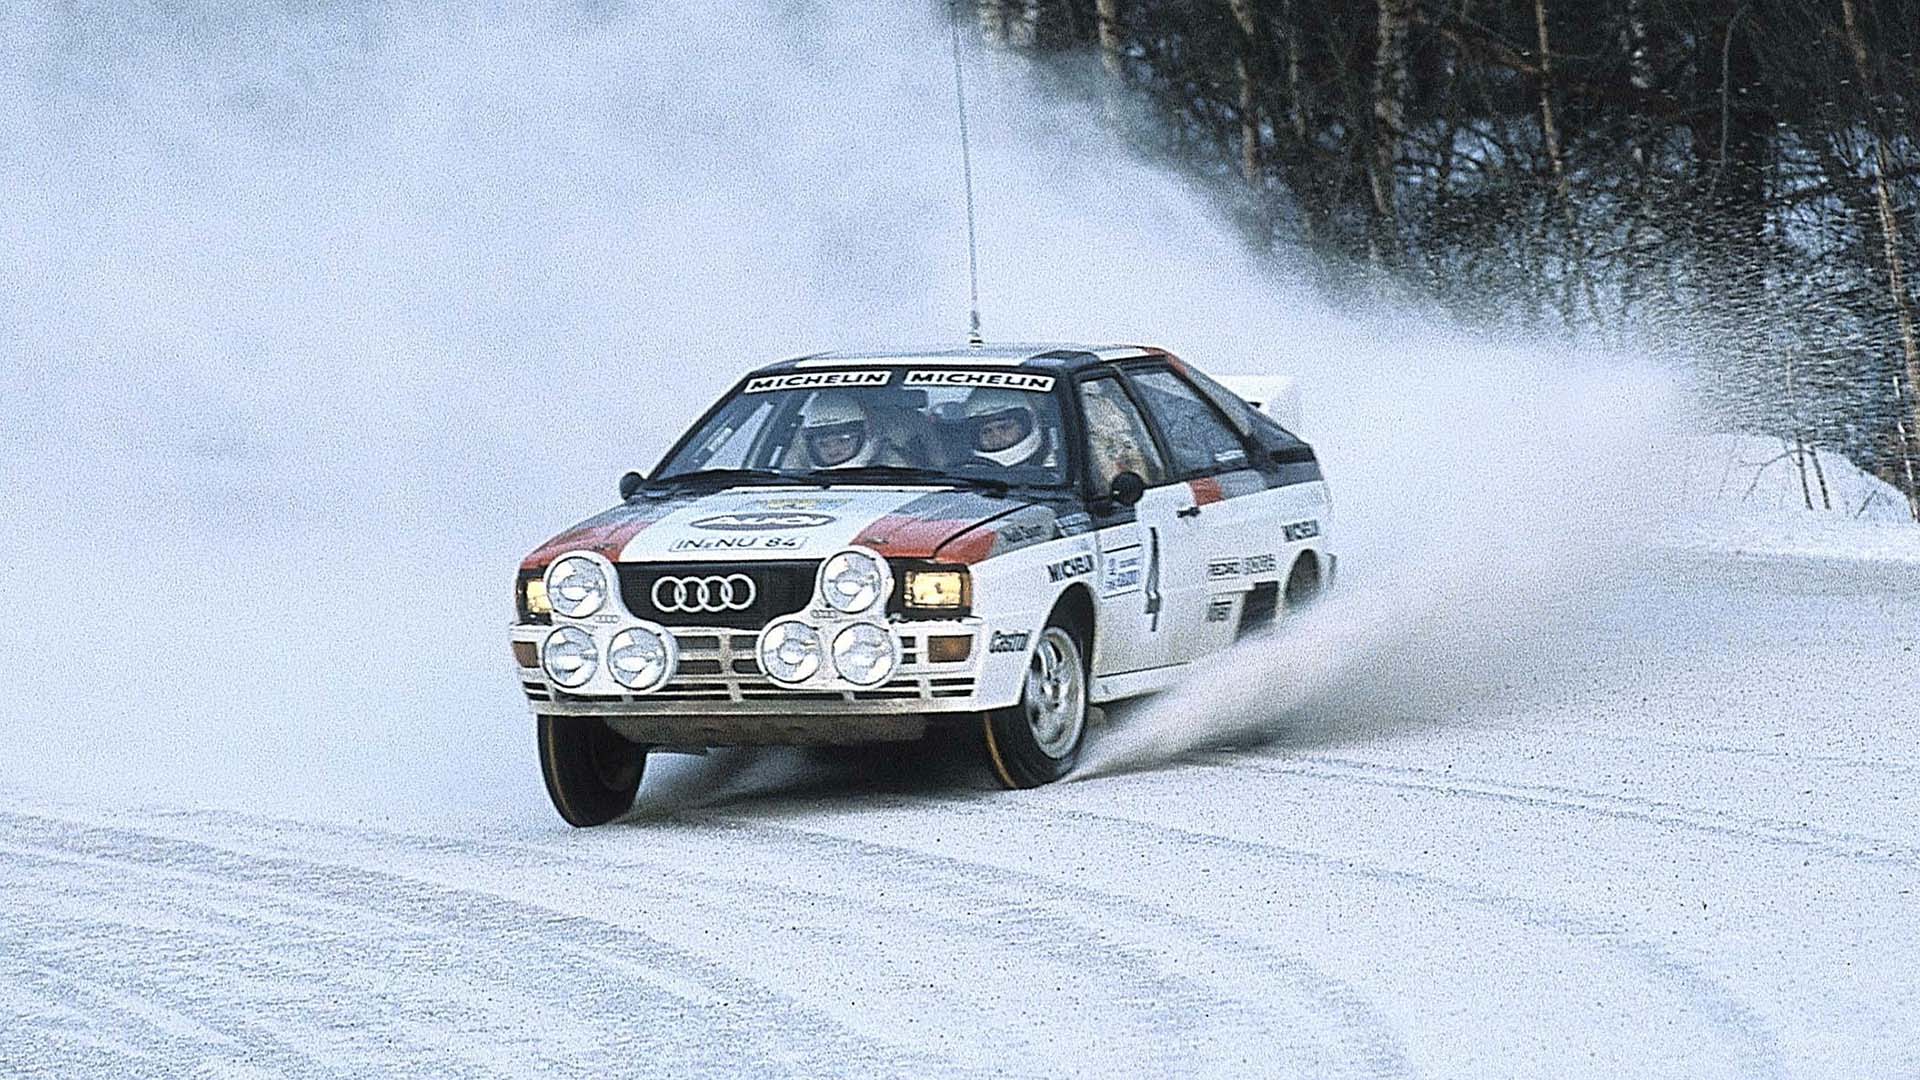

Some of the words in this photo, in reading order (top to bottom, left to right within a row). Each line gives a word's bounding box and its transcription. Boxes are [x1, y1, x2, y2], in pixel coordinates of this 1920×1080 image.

[749, 373, 885, 390] MICHELIN
[909, 373, 1049, 389] MICHELIN
[764, 537, 798, 548] 84
